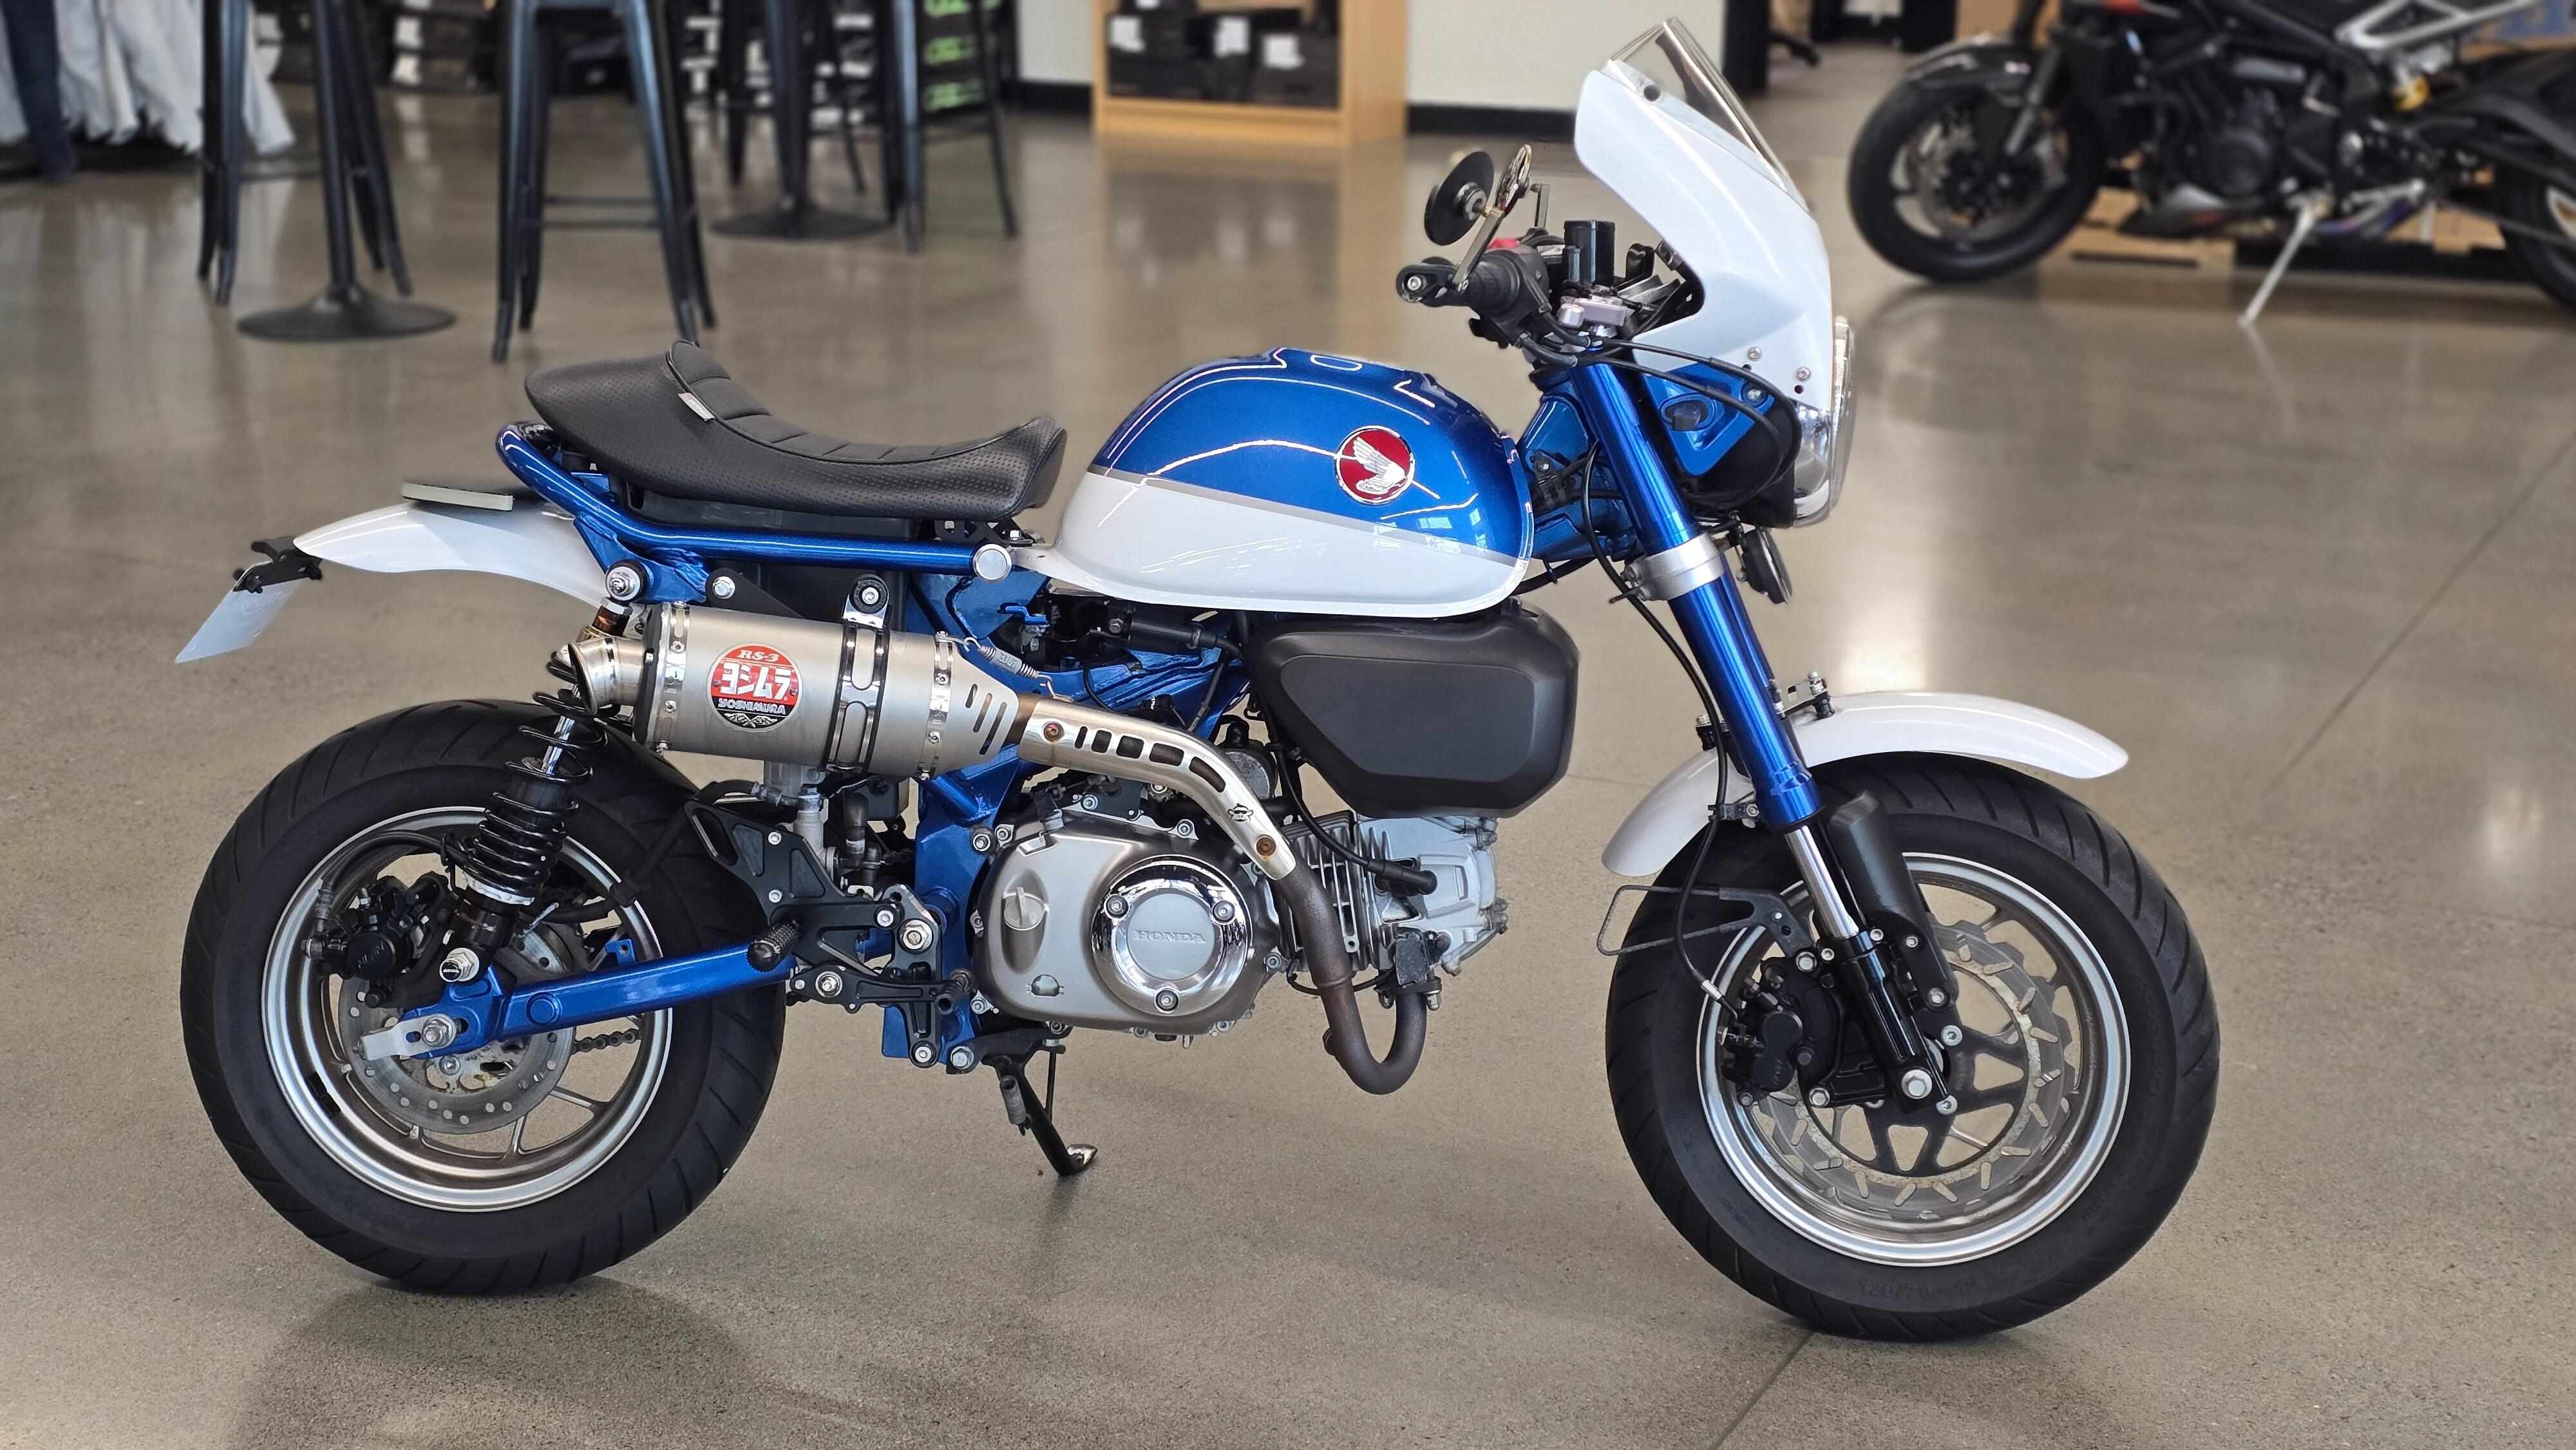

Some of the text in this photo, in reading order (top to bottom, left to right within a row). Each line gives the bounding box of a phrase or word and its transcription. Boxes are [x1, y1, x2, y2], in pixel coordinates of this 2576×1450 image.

[737, 650, 779, 662] RS-3
[719, 661, 792, 701] ヨシムラ
[717, 697, 786, 715] YOSHIMURA
[1134, 930, 1208, 944] HONDA
